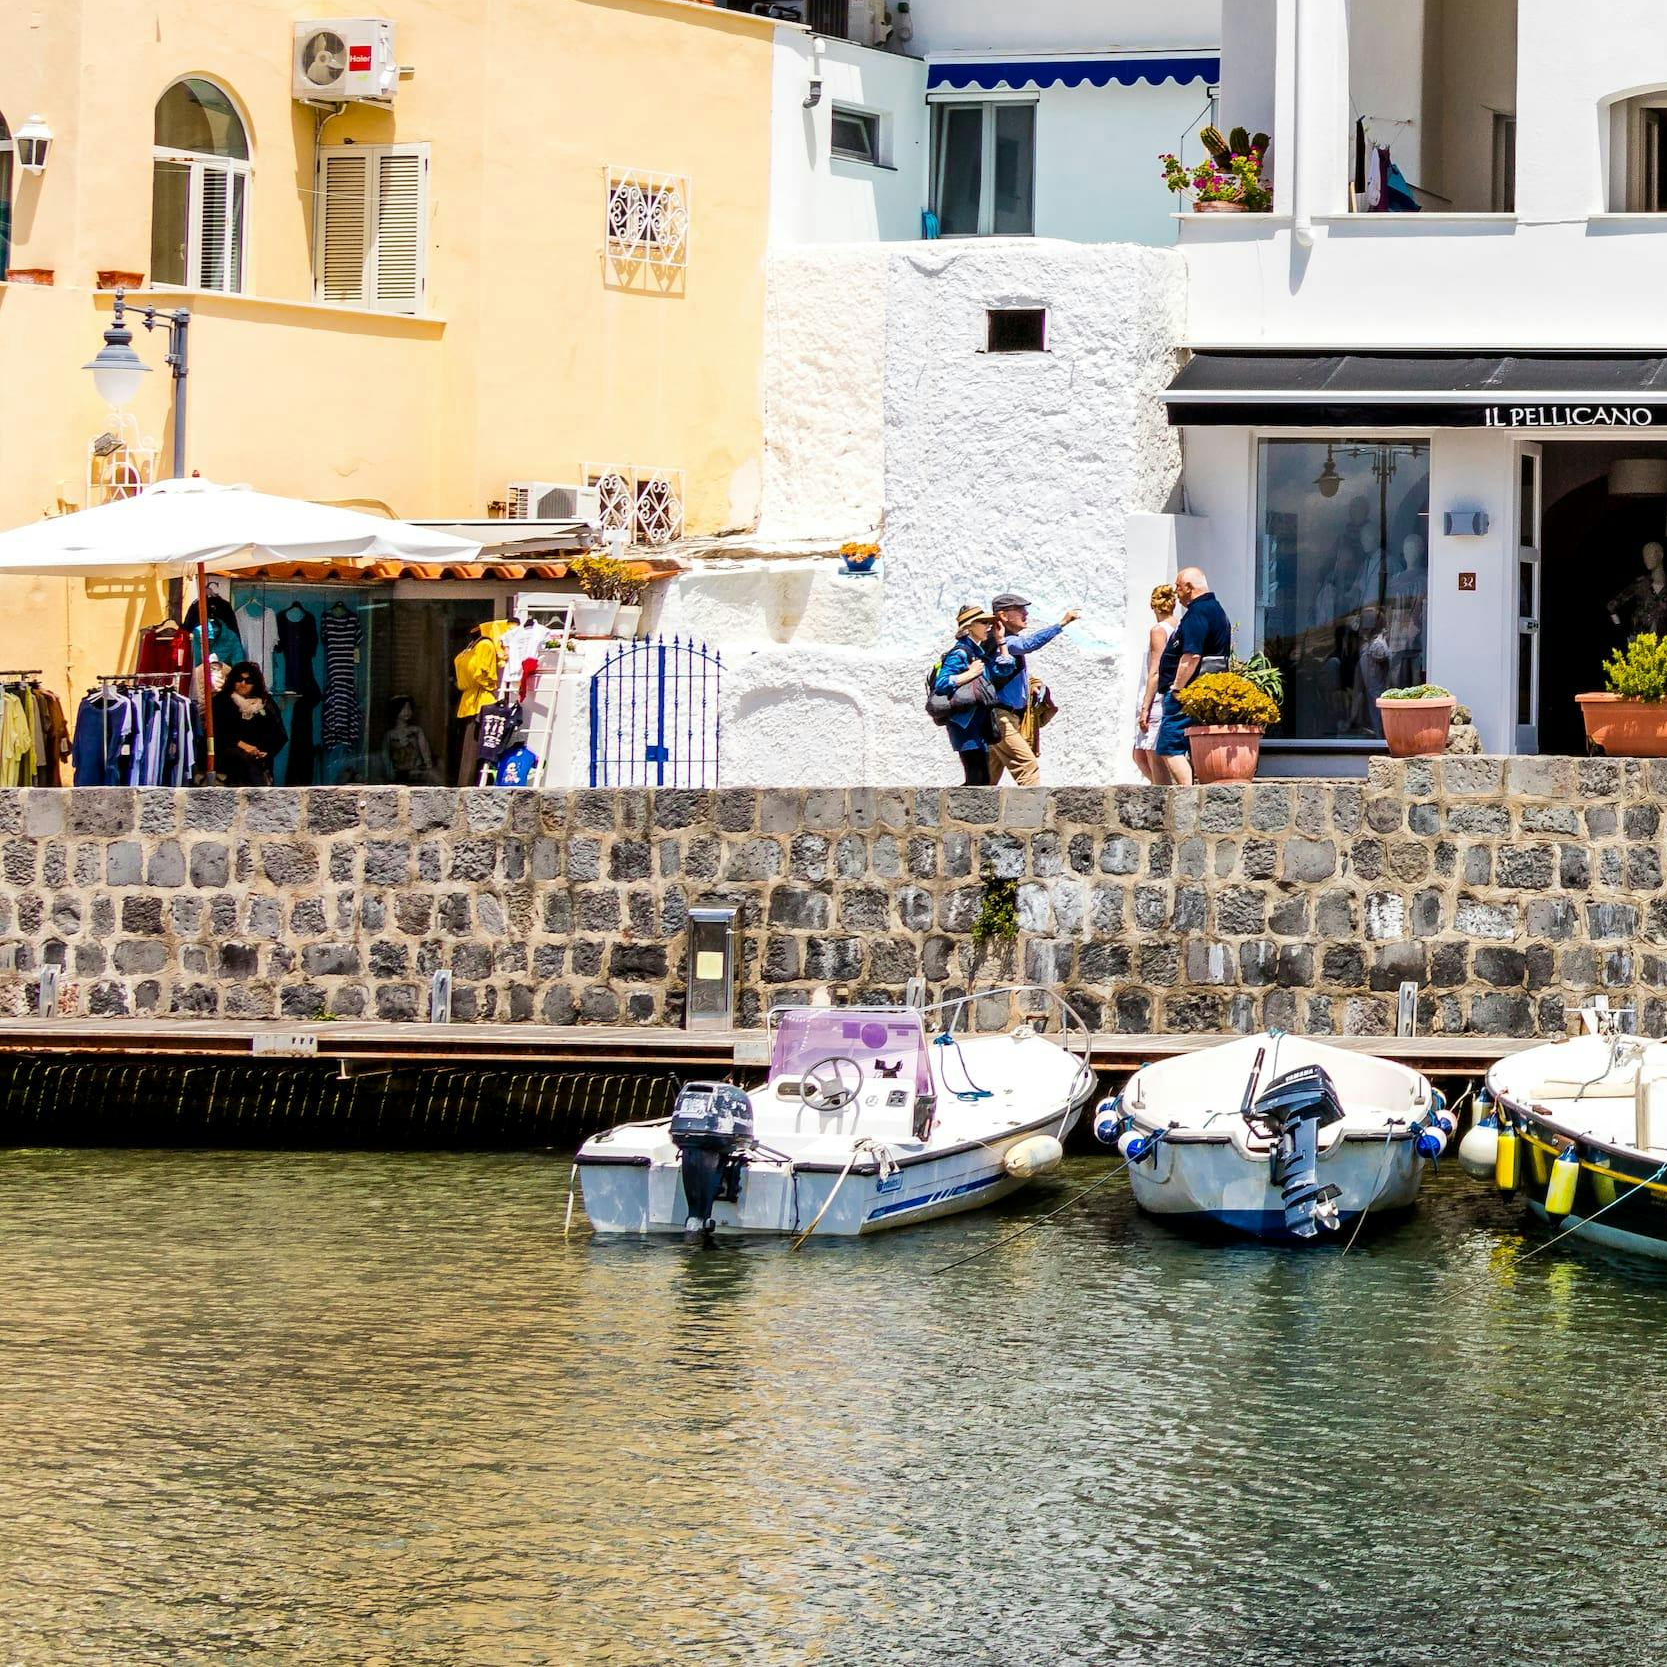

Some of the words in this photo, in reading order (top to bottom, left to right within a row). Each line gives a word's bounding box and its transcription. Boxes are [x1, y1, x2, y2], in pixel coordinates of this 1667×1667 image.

[350, 54, 371, 62] Haier
[1485, 407, 1506, 427] IL
[1509, 407, 1652, 427] PELLICANO
[1463, 576, 1474, 588] 32
